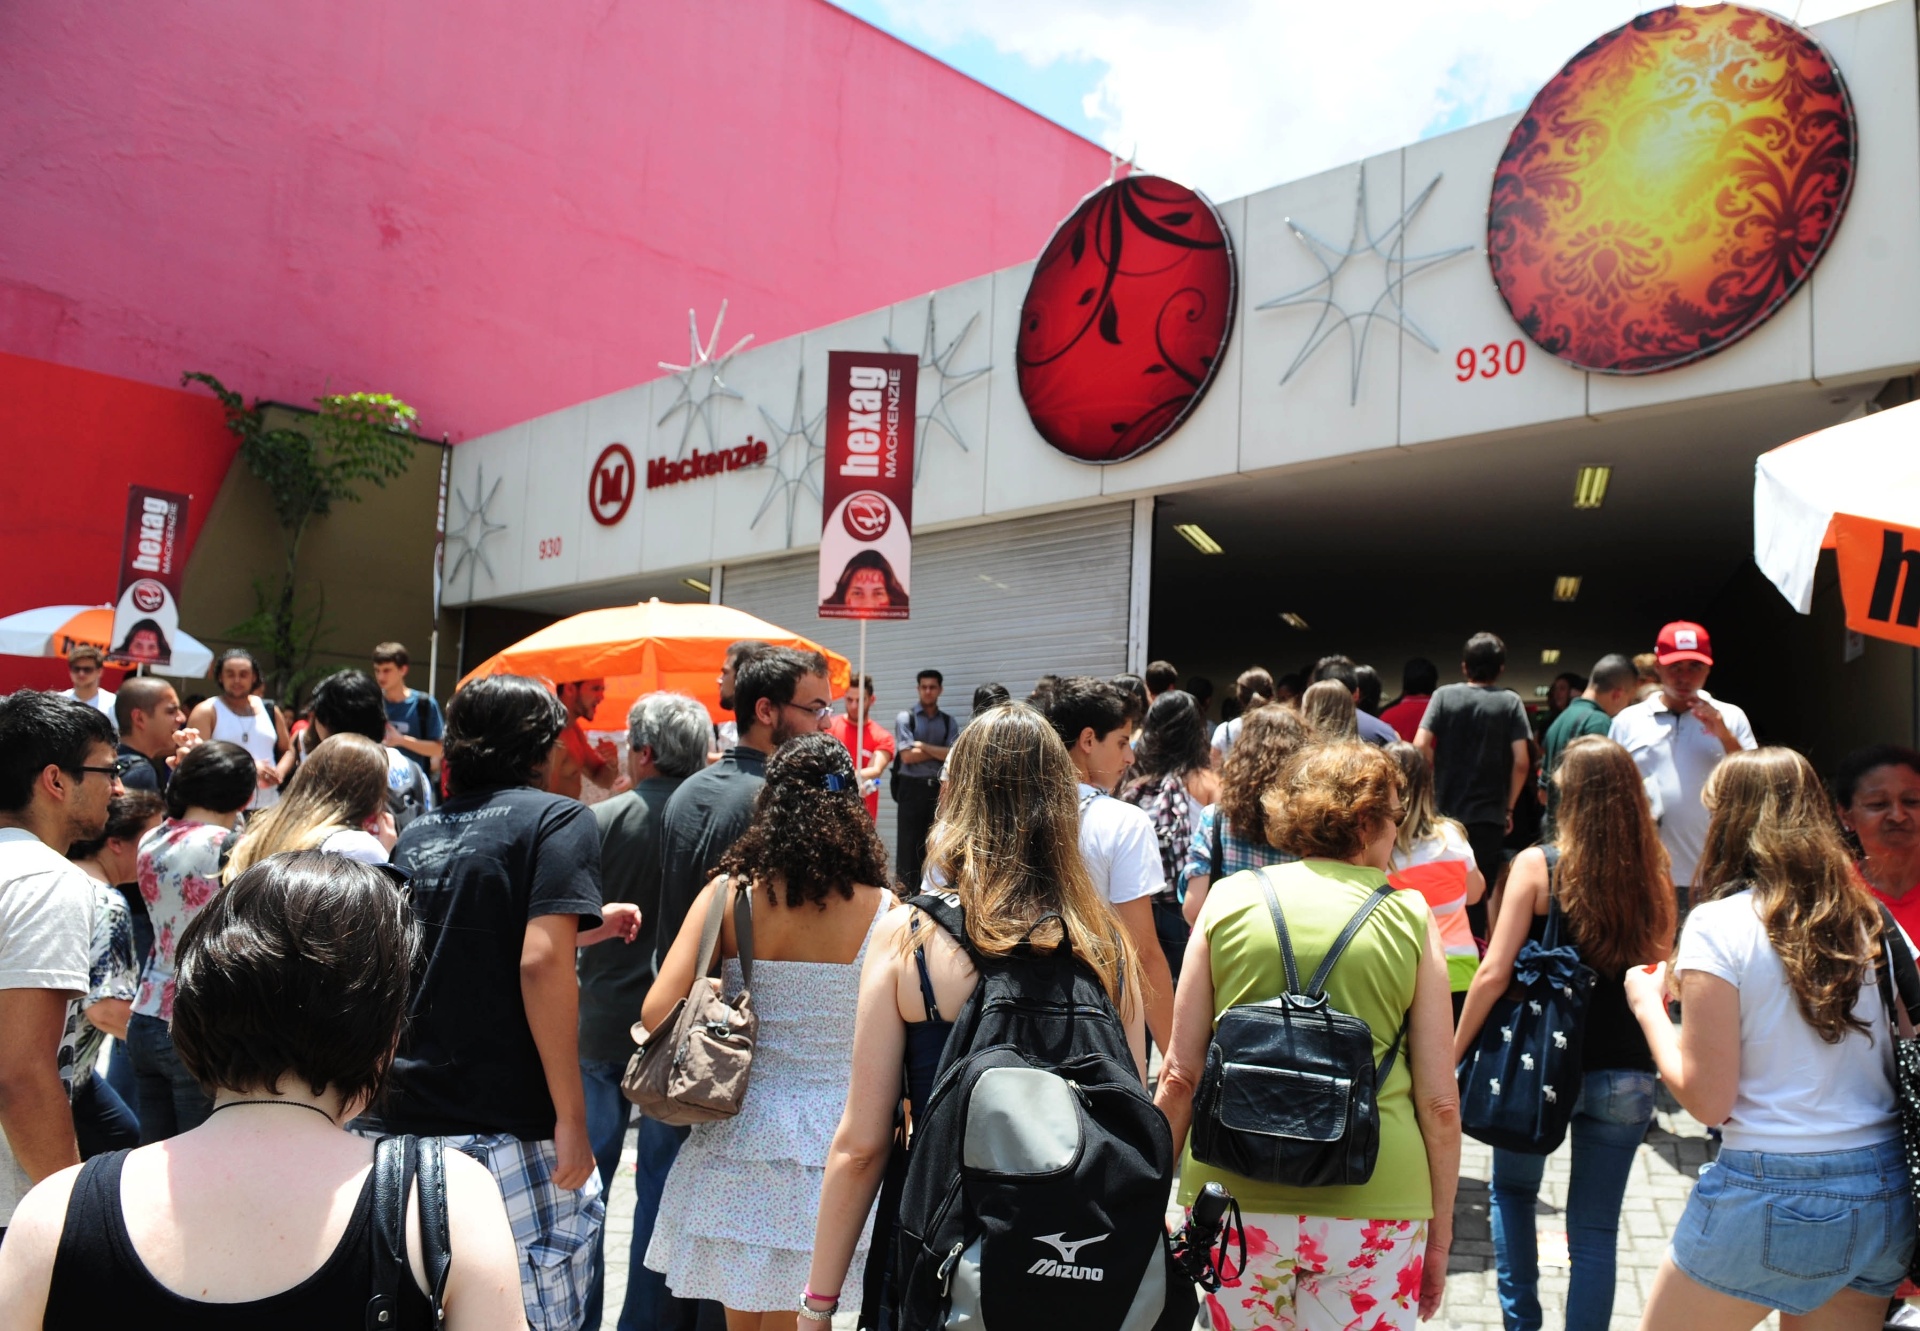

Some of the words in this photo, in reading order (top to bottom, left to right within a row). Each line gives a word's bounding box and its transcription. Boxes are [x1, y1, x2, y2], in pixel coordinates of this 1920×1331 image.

[1456, 339, 1526, 382] 930
[839, 366, 888, 477] hexag
[884, 368, 901, 478] MACKENZIE
[646, 435, 768, 489] Mackenzie
[132, 496, 169, 572] hexag
[162, 502, 178, 574] MACKENZIE
[539, 536, 562, 560] 930
[1026, 1258, 1104, 1281] MIZUNO
